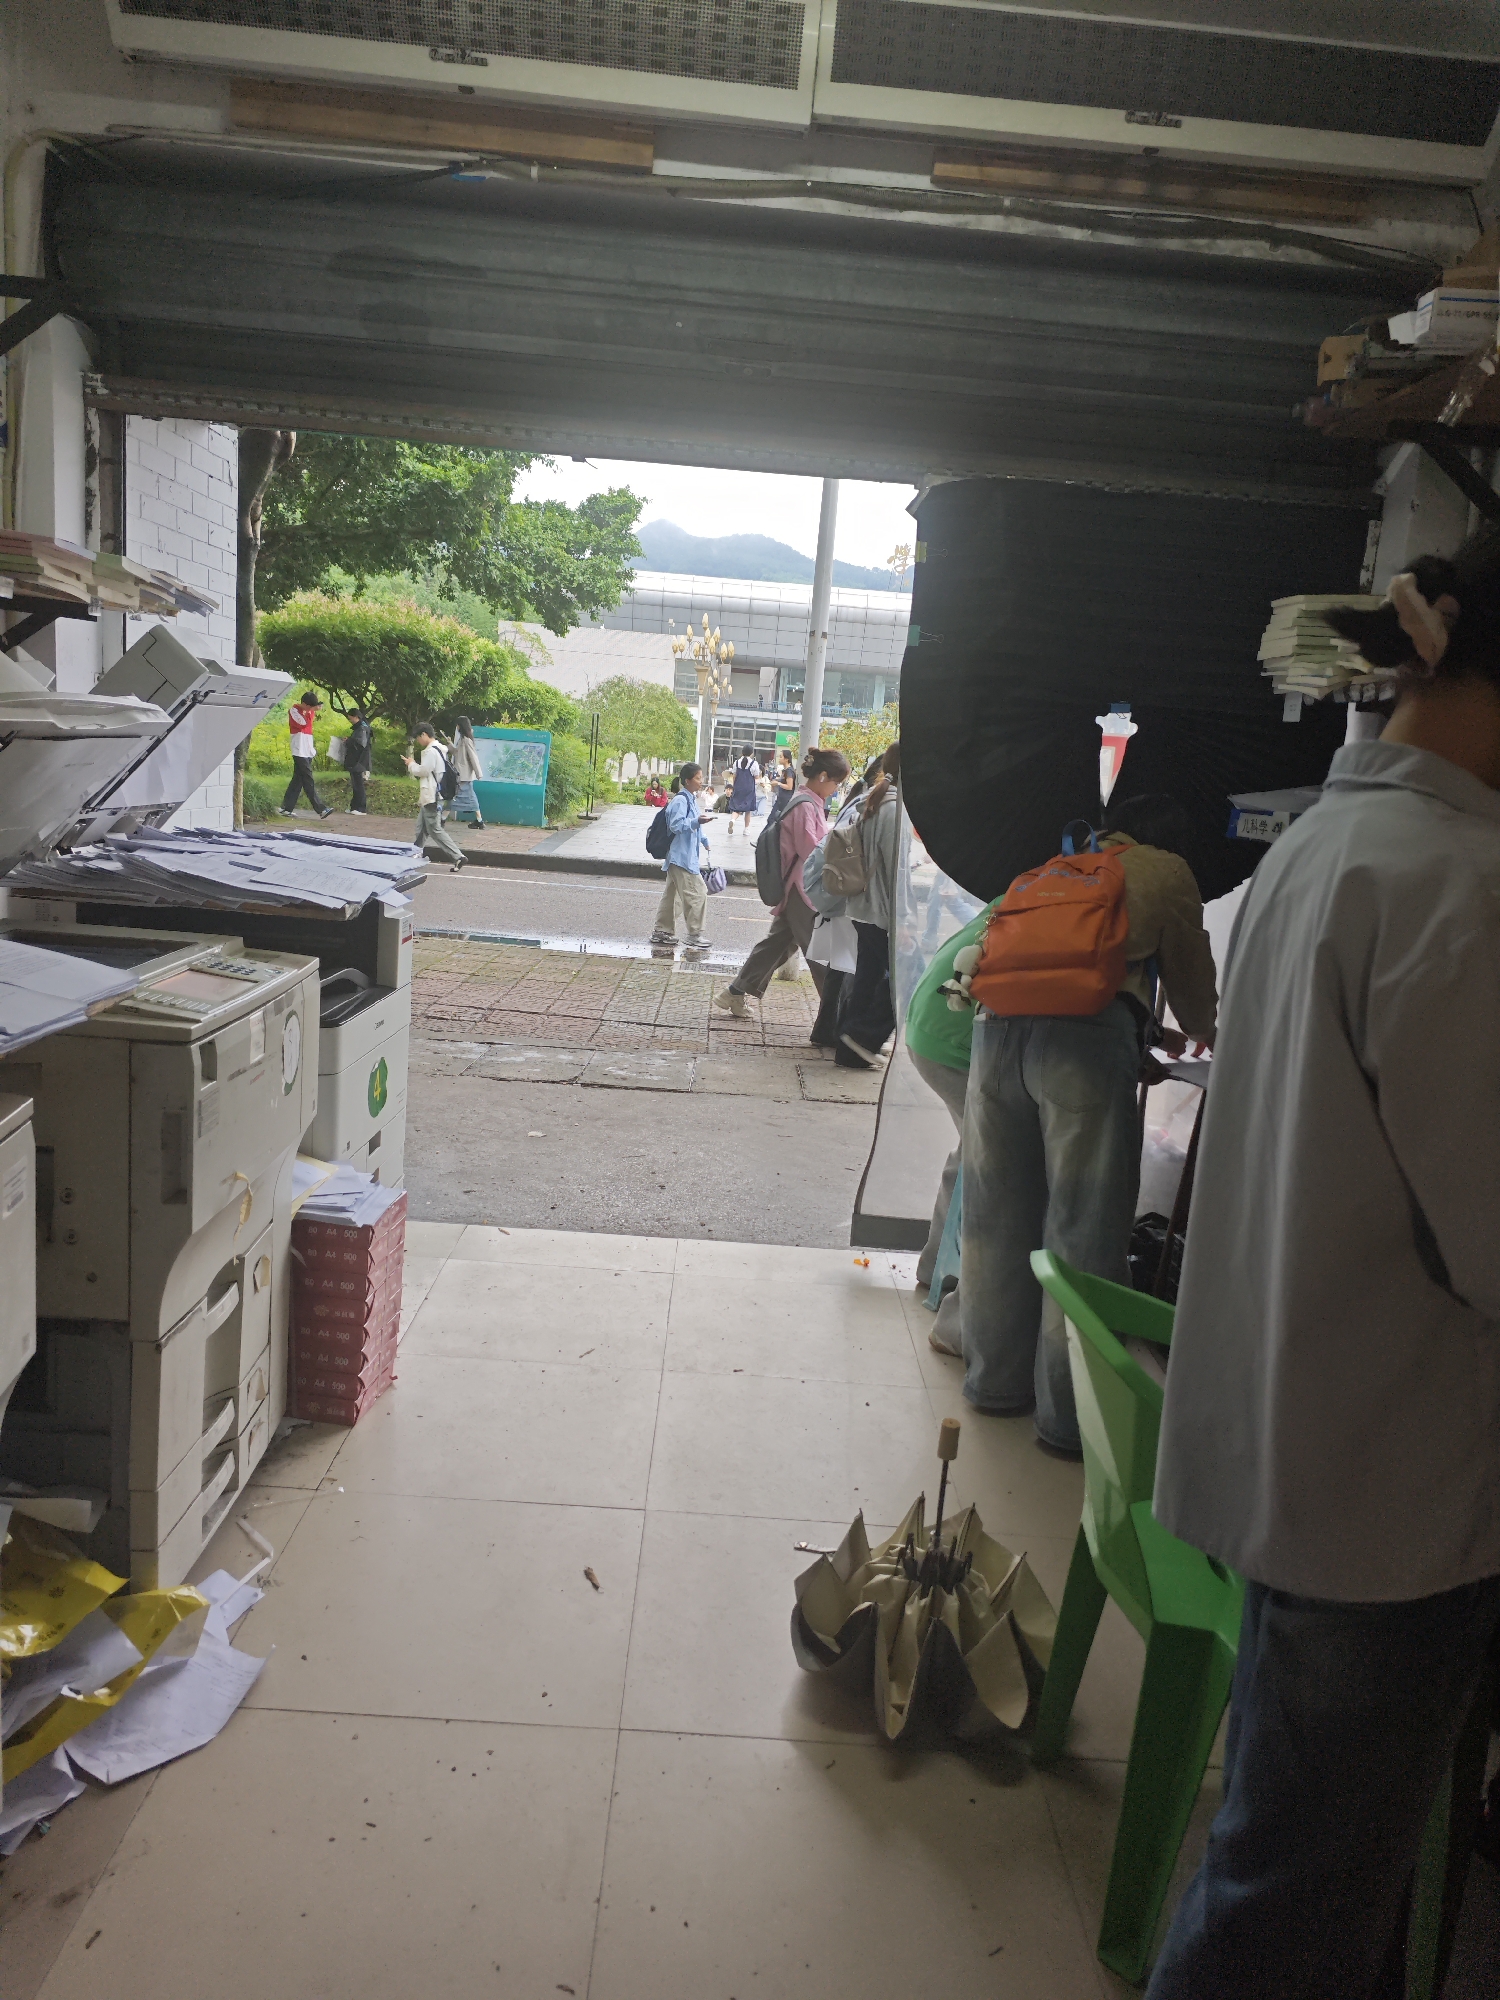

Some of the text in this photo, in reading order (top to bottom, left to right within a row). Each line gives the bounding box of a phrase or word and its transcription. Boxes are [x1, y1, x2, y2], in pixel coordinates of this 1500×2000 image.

[1241, 818, 1268, 835] 儿科学
[374, 1069, 381, 1101] 4
[326, 1228, 337, 1236] A4
[344, 1230, 358, 1239] 500
[325, 1250, 336, 1258] A4
[344, 1253, 357, 1261] 500
[341, 1282, 354, 1290] 500
[336, 1332, 350, 1340] 500
[318, 1354, 329, 1362] A4
[335, 1357, 349, 1365] 500
[332, 1382, 346, 1390] 500
